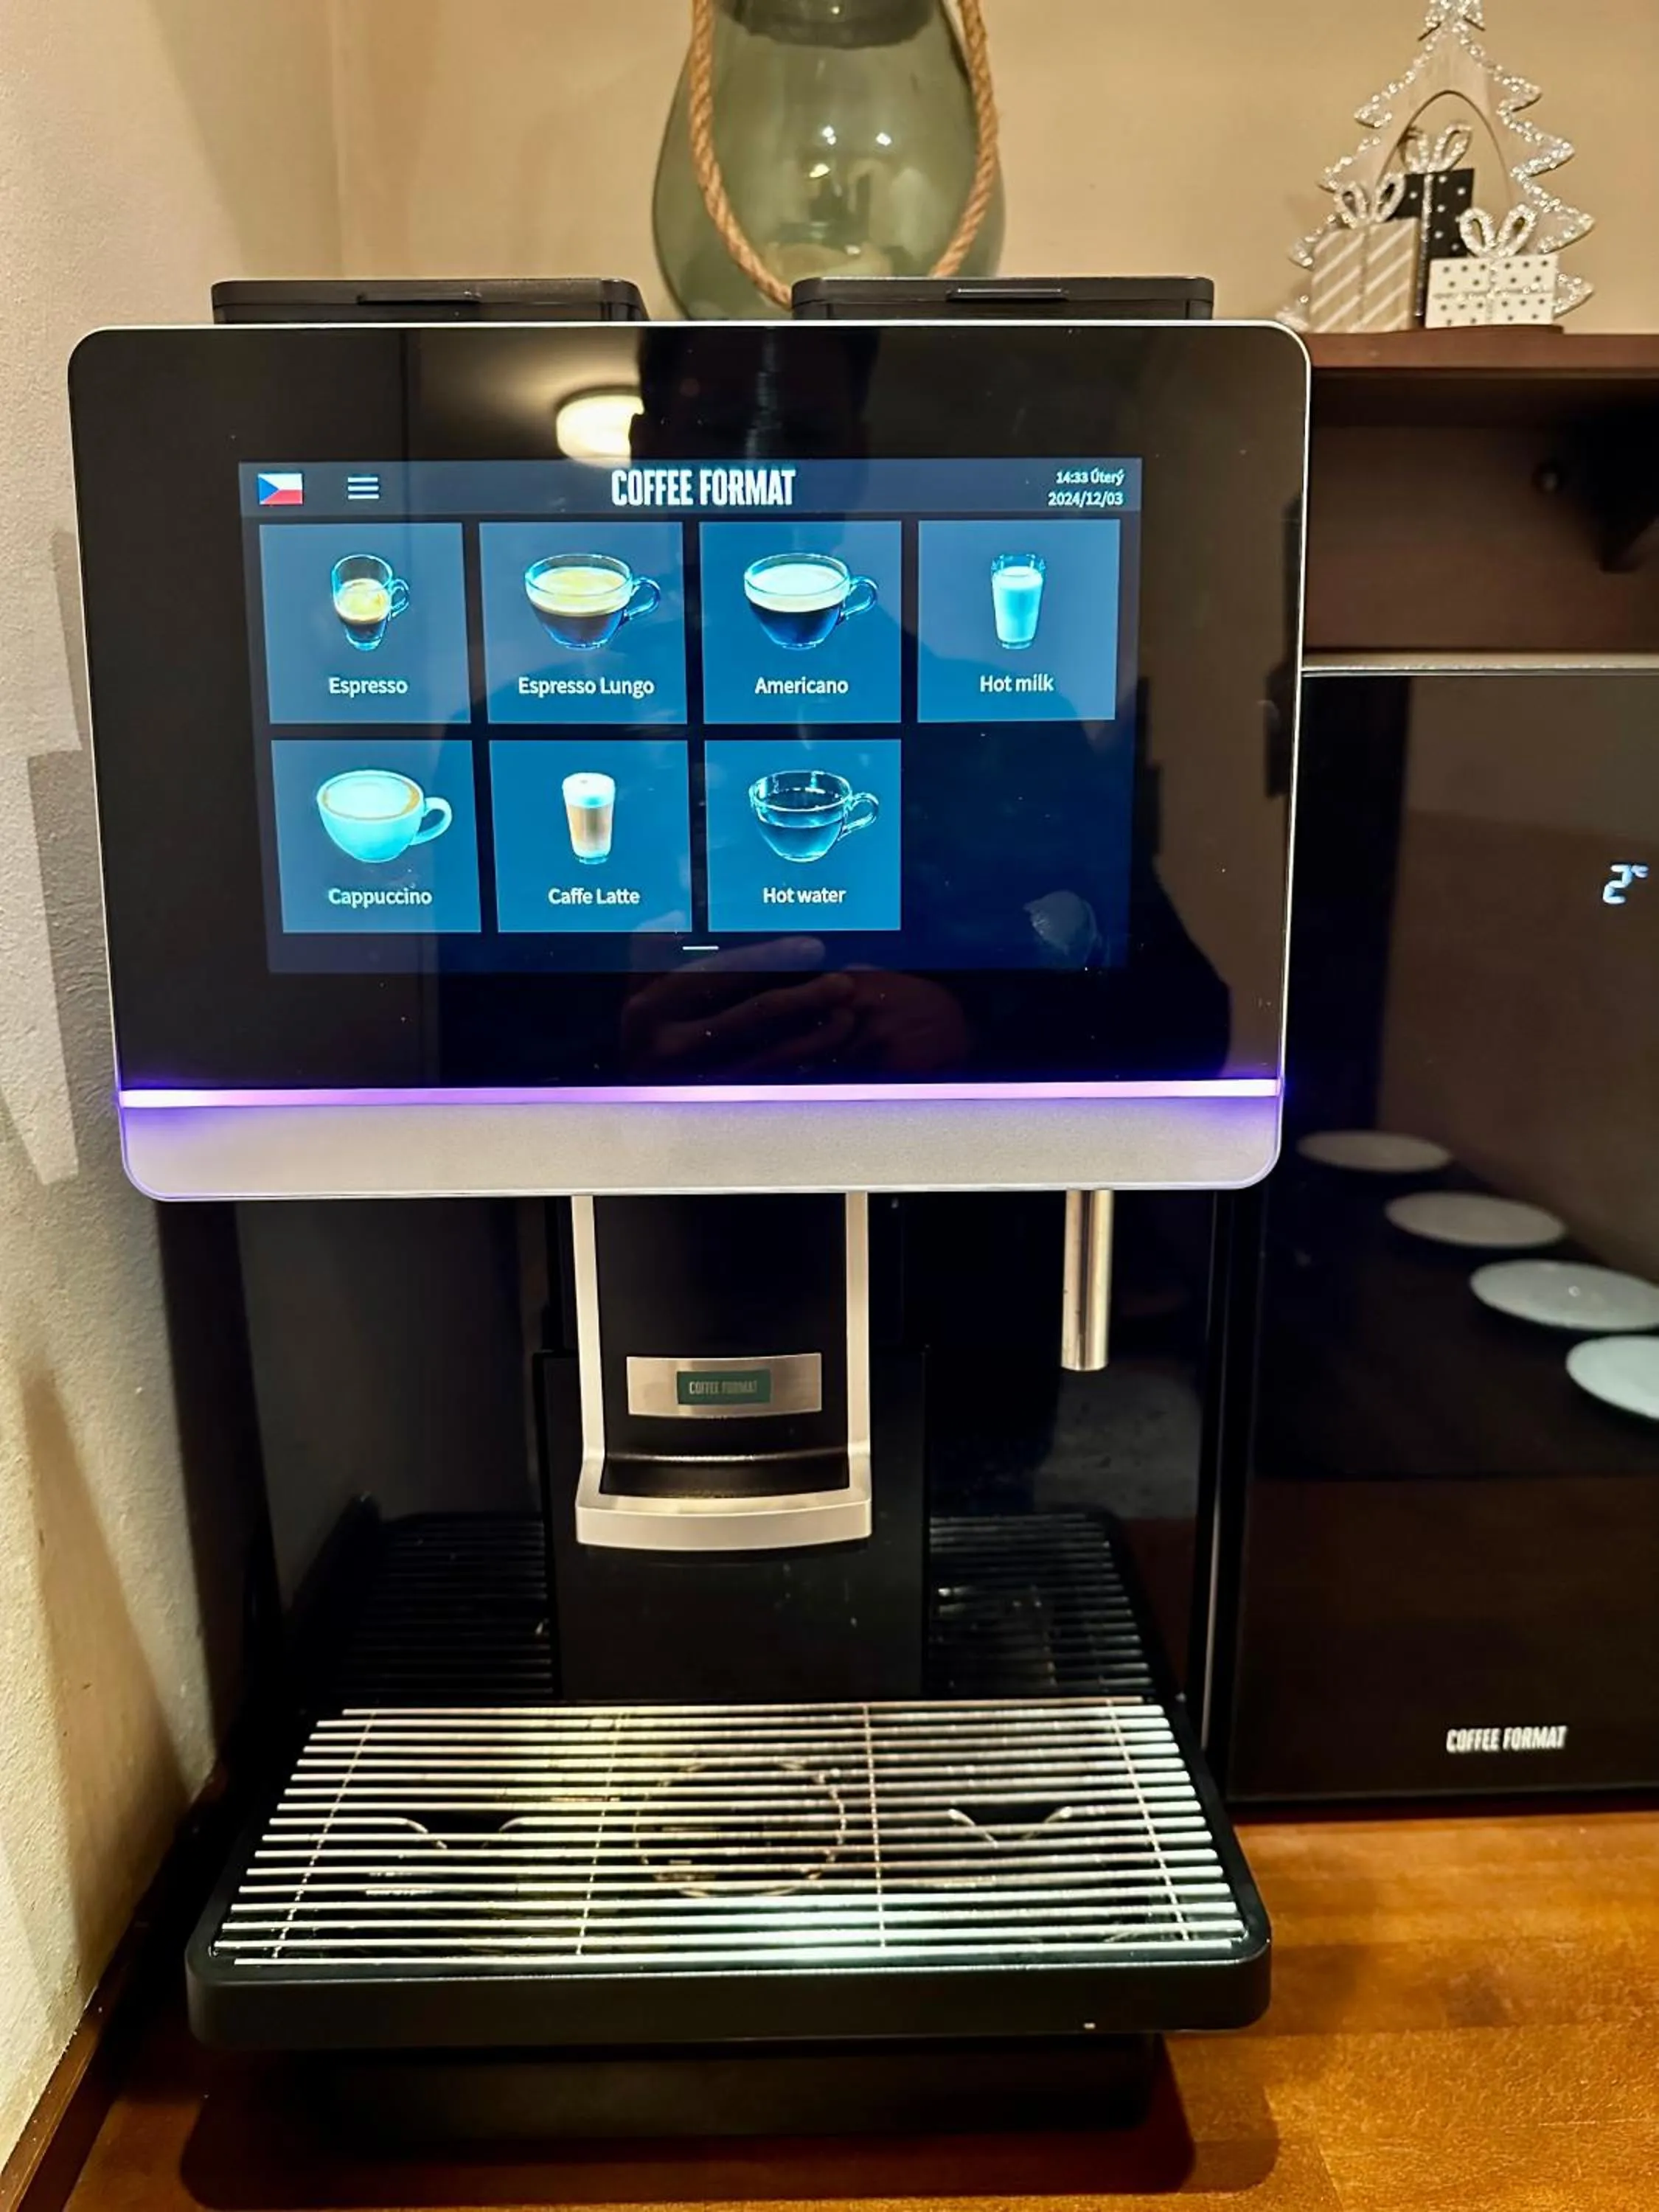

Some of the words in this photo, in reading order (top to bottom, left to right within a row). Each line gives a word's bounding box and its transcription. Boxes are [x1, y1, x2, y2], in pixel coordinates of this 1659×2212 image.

[1056, 471, 1088, 484] 14:33
[1091, 467, 1124, 487] Úterý
[611, 470, 693, 507] COFFEE
[700, 469, 796, 507] FORMAT
[1048, 490, 1124, 508] 2024/12/03
[329, 677, 408, 698] Espresso
[518, 677, 596, 698] Espresso
[600, 677, 654, 698] Lungo
[755, 676, 849, 695] Americano
[980, 675, 1012, 695] Hot
[1015, 675, 1054, 694] milk
[327, 887, 433, 909] Cappuccino
[548, 887, 593, 905] Caffe
[597, 887, 640, 905] Latte
[762, 886, 794, 905] Hot
[797, 888, 846, 905] water
[689, 1381, 720, 1395] COFFEE
[1446, 1728, 1501, 1753] COFFEE
[1503, 1725, 1568, 1750] FORMAT
